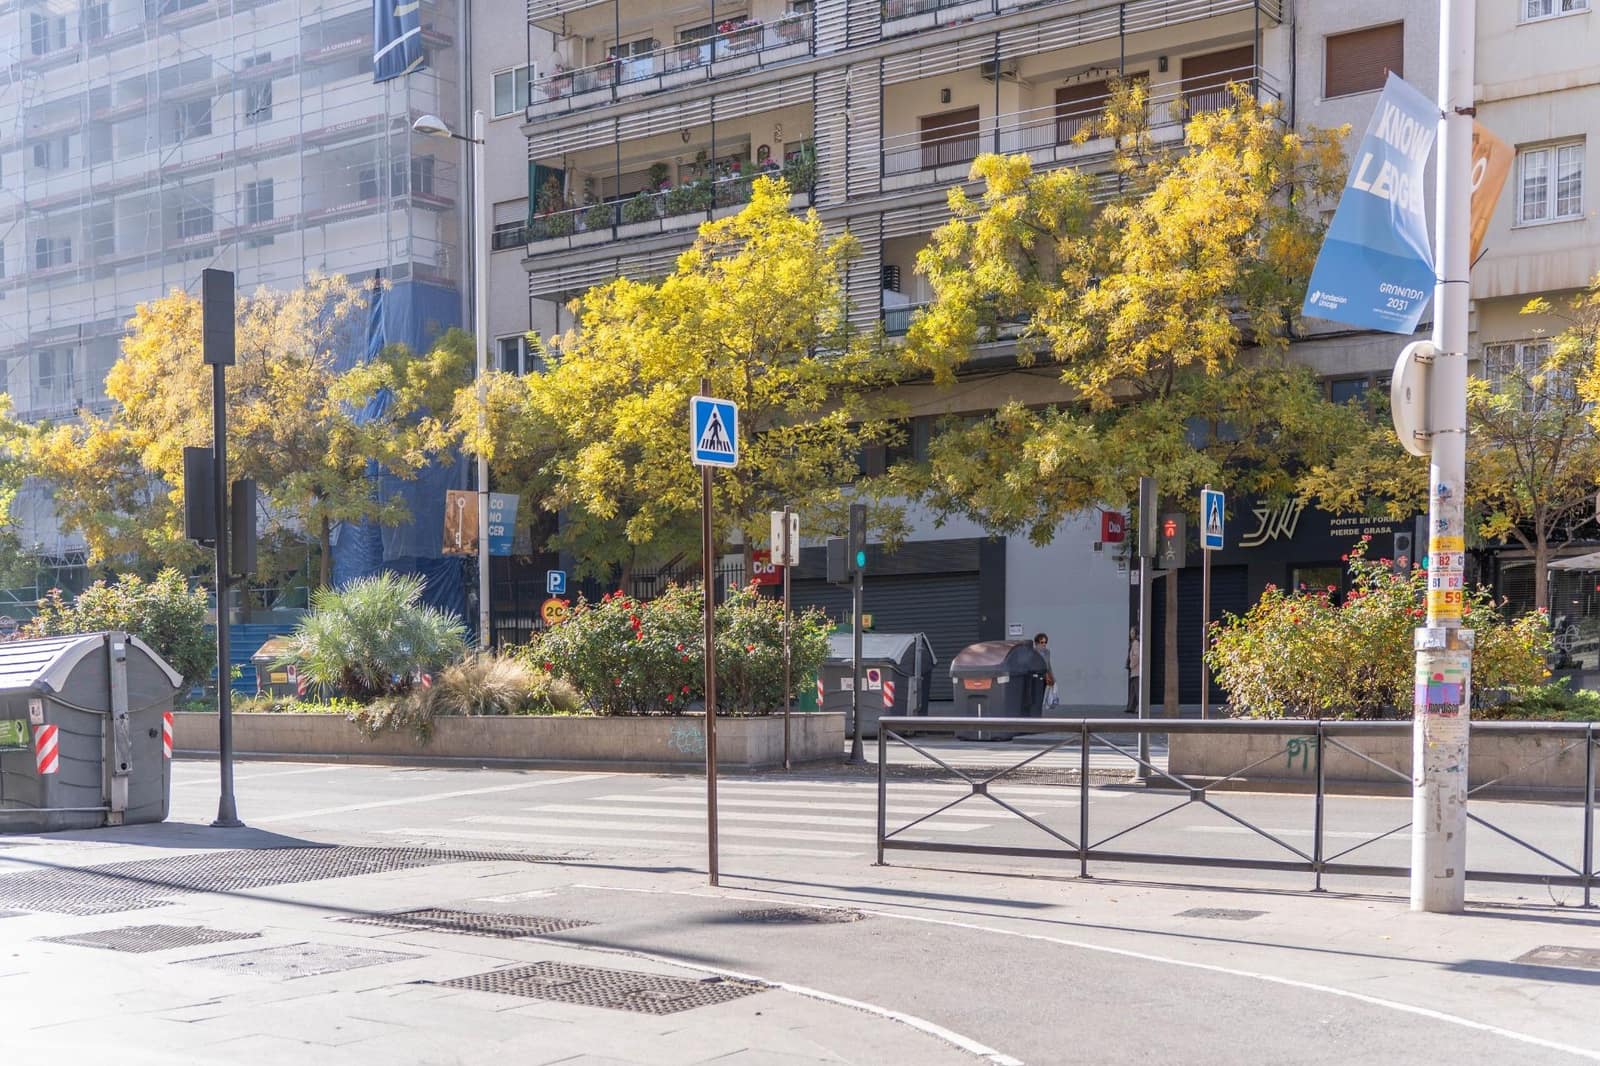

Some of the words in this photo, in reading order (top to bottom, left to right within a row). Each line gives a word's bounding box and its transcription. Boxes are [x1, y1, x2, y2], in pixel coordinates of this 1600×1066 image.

[1375, 101, 1430, 161] KNOW
[1380, 283, 1424, 301] GRANADA
[1387, 297, 1409, 310] 2031
[490, 499, 503, 509] CO
[489, 513, 501, 523] NO
[1330, 517, 1357, 526] PONTE
[1359, 516, 1371, 524] EN
[488, 526, 504, 536] CER
[1330, 529, 1359, 537] PIERDE
[1440, 556, 1450, 566] B2
[550, 573, 561, 591] P
[1445, 592, 1461, 604] 59
